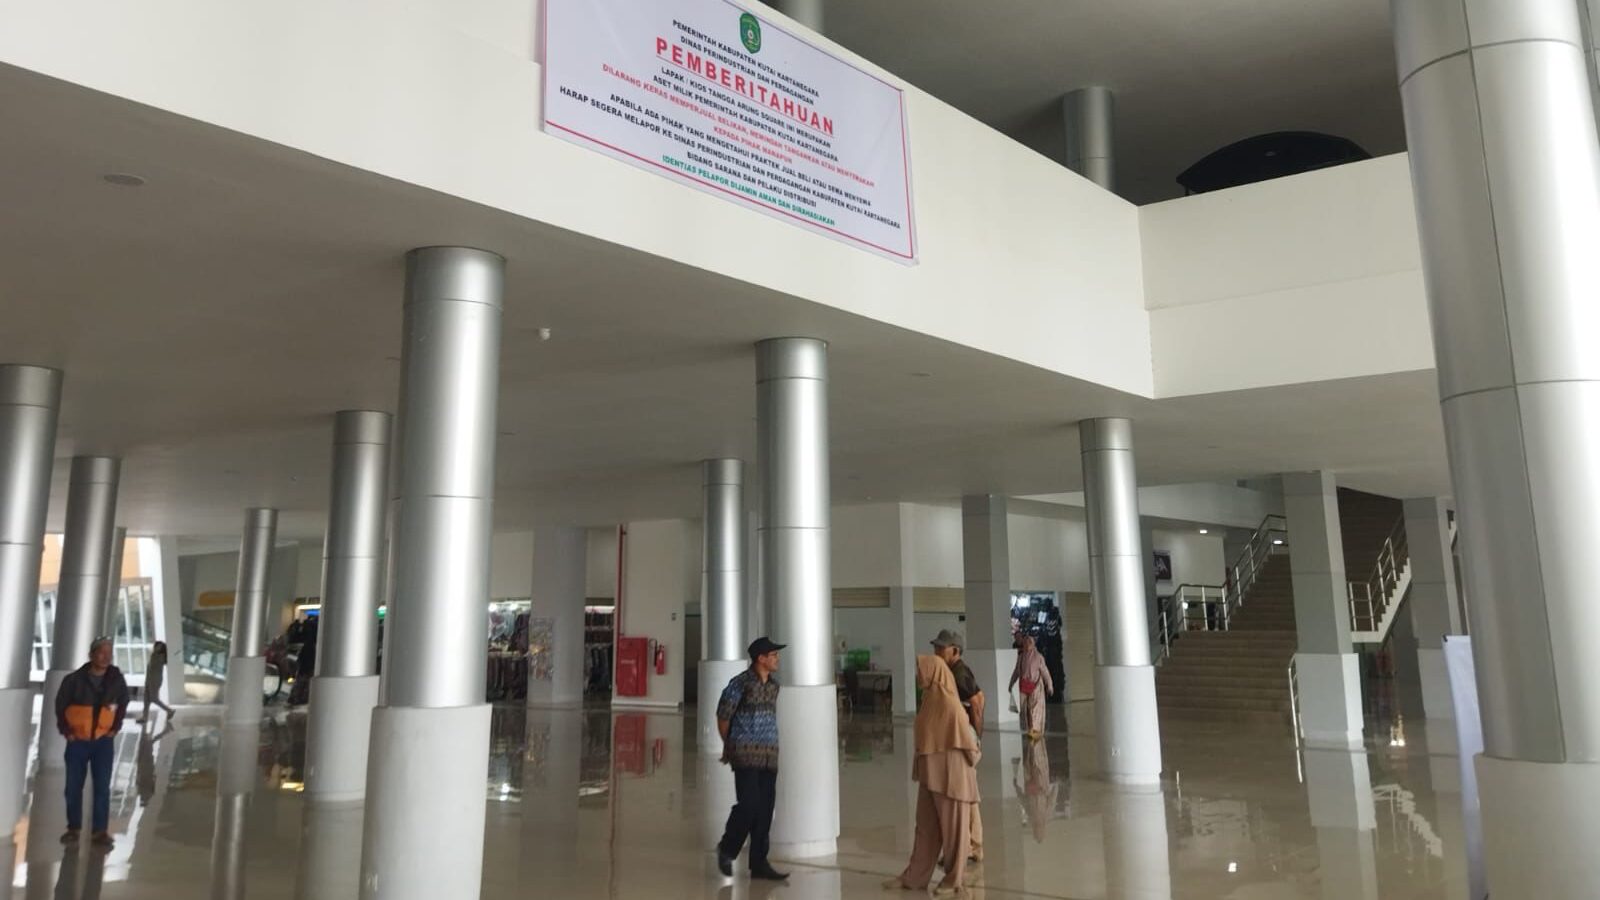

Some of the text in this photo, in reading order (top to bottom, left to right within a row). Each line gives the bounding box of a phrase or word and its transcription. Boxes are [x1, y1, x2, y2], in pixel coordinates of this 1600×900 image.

[656, 37, 833, 134] PEMBERITAHUAN
[673, 20, 819, 97] PEMERINTAH KABUPATEN KUTAI KARTANEGARA
[681, 36, 814, 105] DINAS PERINDUSTRIAN DAN PERDAGANGAN
[602, 64, 641, 88] DILARANG
[643, 83, 668, 98] KERAS
[670, 95, 715, 120] MEMPERJUAL
[821, 160, 835, 171] ATAU
[653, 75, 838, 162] ASET MILIK PEMERINTAH KABUPATEN KUTAI KARTANEGARA
[662, 67, 684, 81] LAPAK
[690, 79, 706, 92] KIOS
[709, 88, 735, 105] TANGGA
[738, 101, 759, 116] ARUNG
[761, 112, 784, 128] SQUARE
[797, 128, 831, 148] MERUPAKAN
[714, 127, 739, 140] KEPADA
[741, 137, 760, 149] PIHAK
[560, 86, 900, 229] HARAP SEGERA MELAPOR KE DINAS PERINDUSTRIAN DAN PERDAGANGAN KABUPATEN KUTAI KARTANEGARA
[610, 94, 871, 207] APABILA ADA PIHAK YANG MENGETAHUI PRAKTEK JUAL BELI ATAU SEWA MENYEWA
[687, 152, 817, 208] BIDANG SARANA DAN PELAKU DISTRIBUSI
[699, 169, 729, 186] PELAPOR
[731, 182, 757, 197] DIJAMIN
[759, 191, 777, 204] AMAN
[778, 199, 790, 209] DAN
[792, 204, 835, 225] DIRAHASIAKAN
